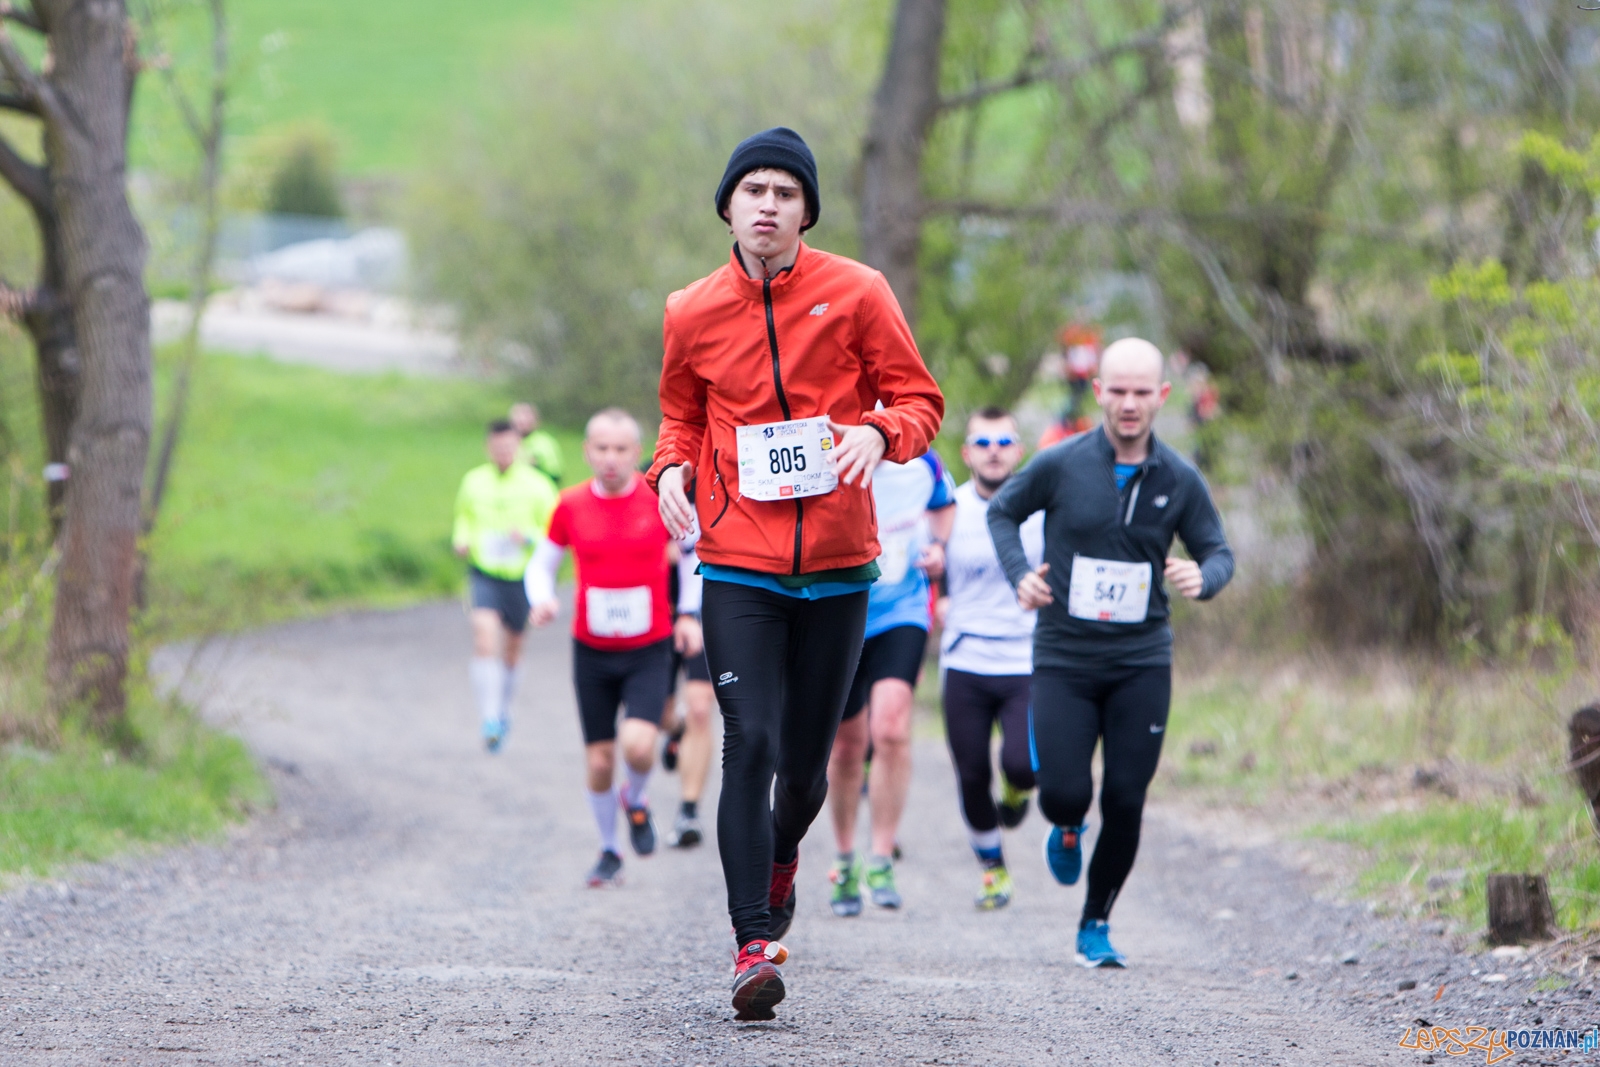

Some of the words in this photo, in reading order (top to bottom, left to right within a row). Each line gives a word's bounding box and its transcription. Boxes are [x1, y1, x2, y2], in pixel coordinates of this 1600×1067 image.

[809, 303, 830, 316] 4F
[769, 446, 807, 475] 805
[803, 472, 822, 481] 10KM
[1094, 581, 1127, 603] 547
